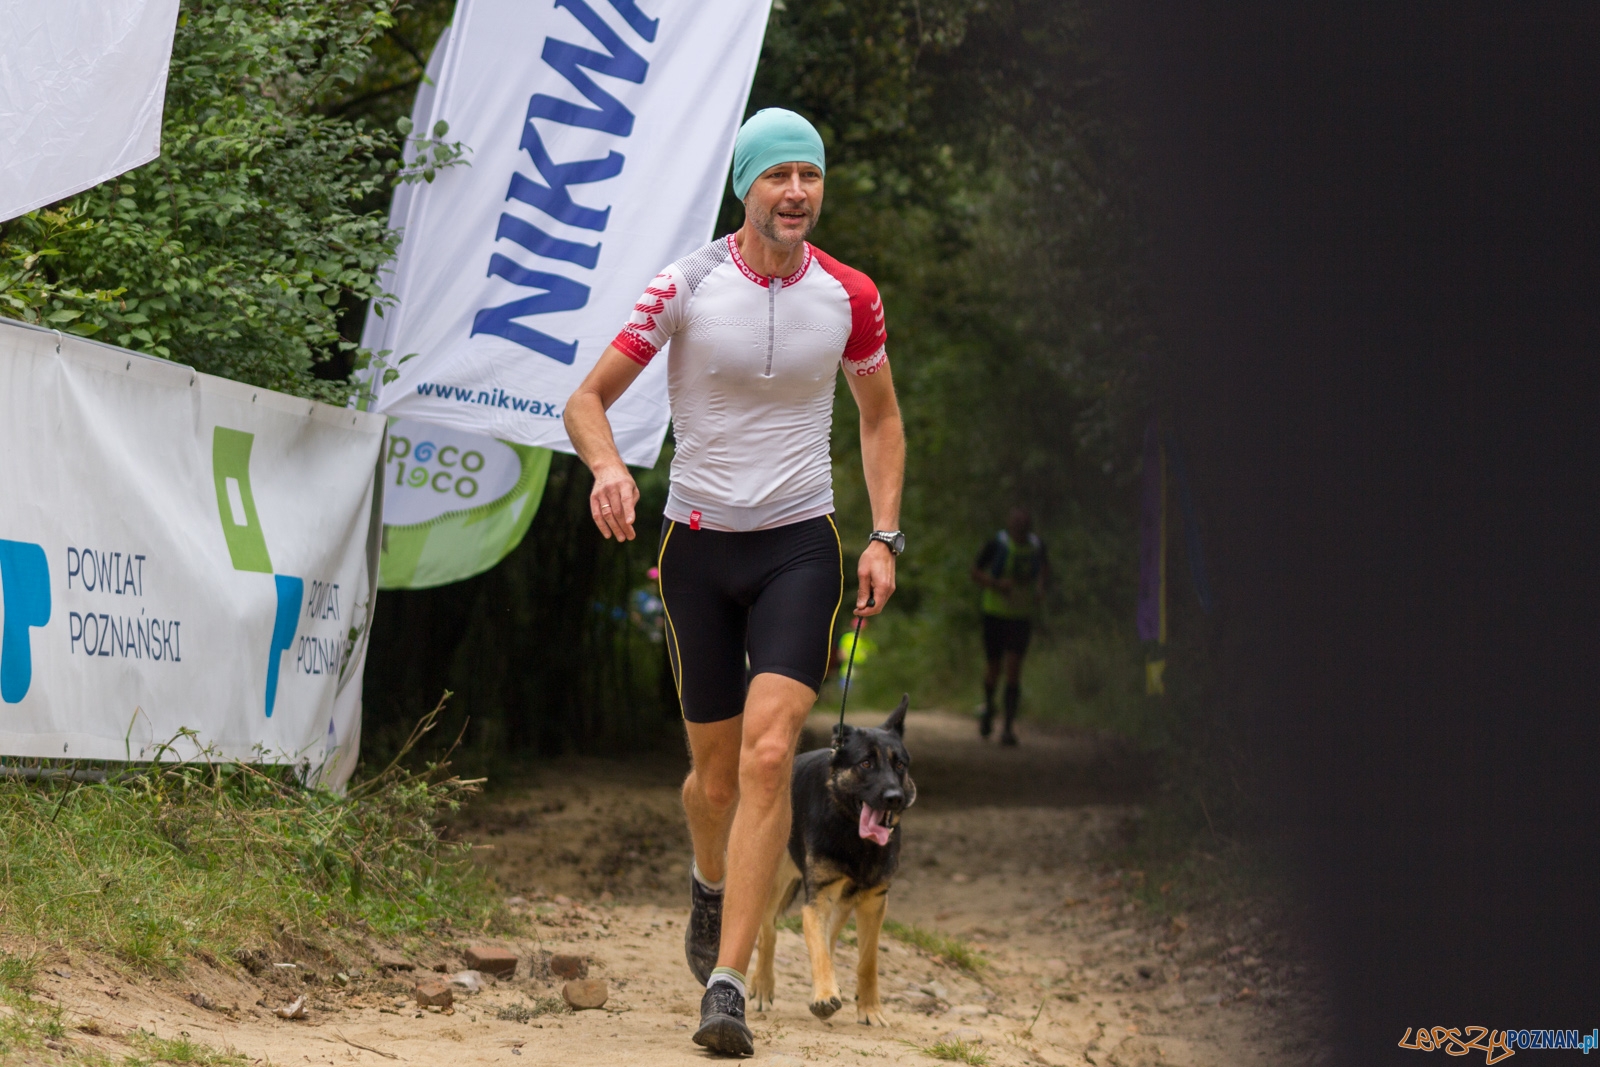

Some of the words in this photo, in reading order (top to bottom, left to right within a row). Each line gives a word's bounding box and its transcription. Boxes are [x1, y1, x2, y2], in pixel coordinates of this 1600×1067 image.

[469, 0, 661, 366] NIKW
[416, 382, 566, 419] www.nikwax.
[67, 546, 147, 597] POWIAT
[69, 606, 182, 662] POZNAŃSKI
